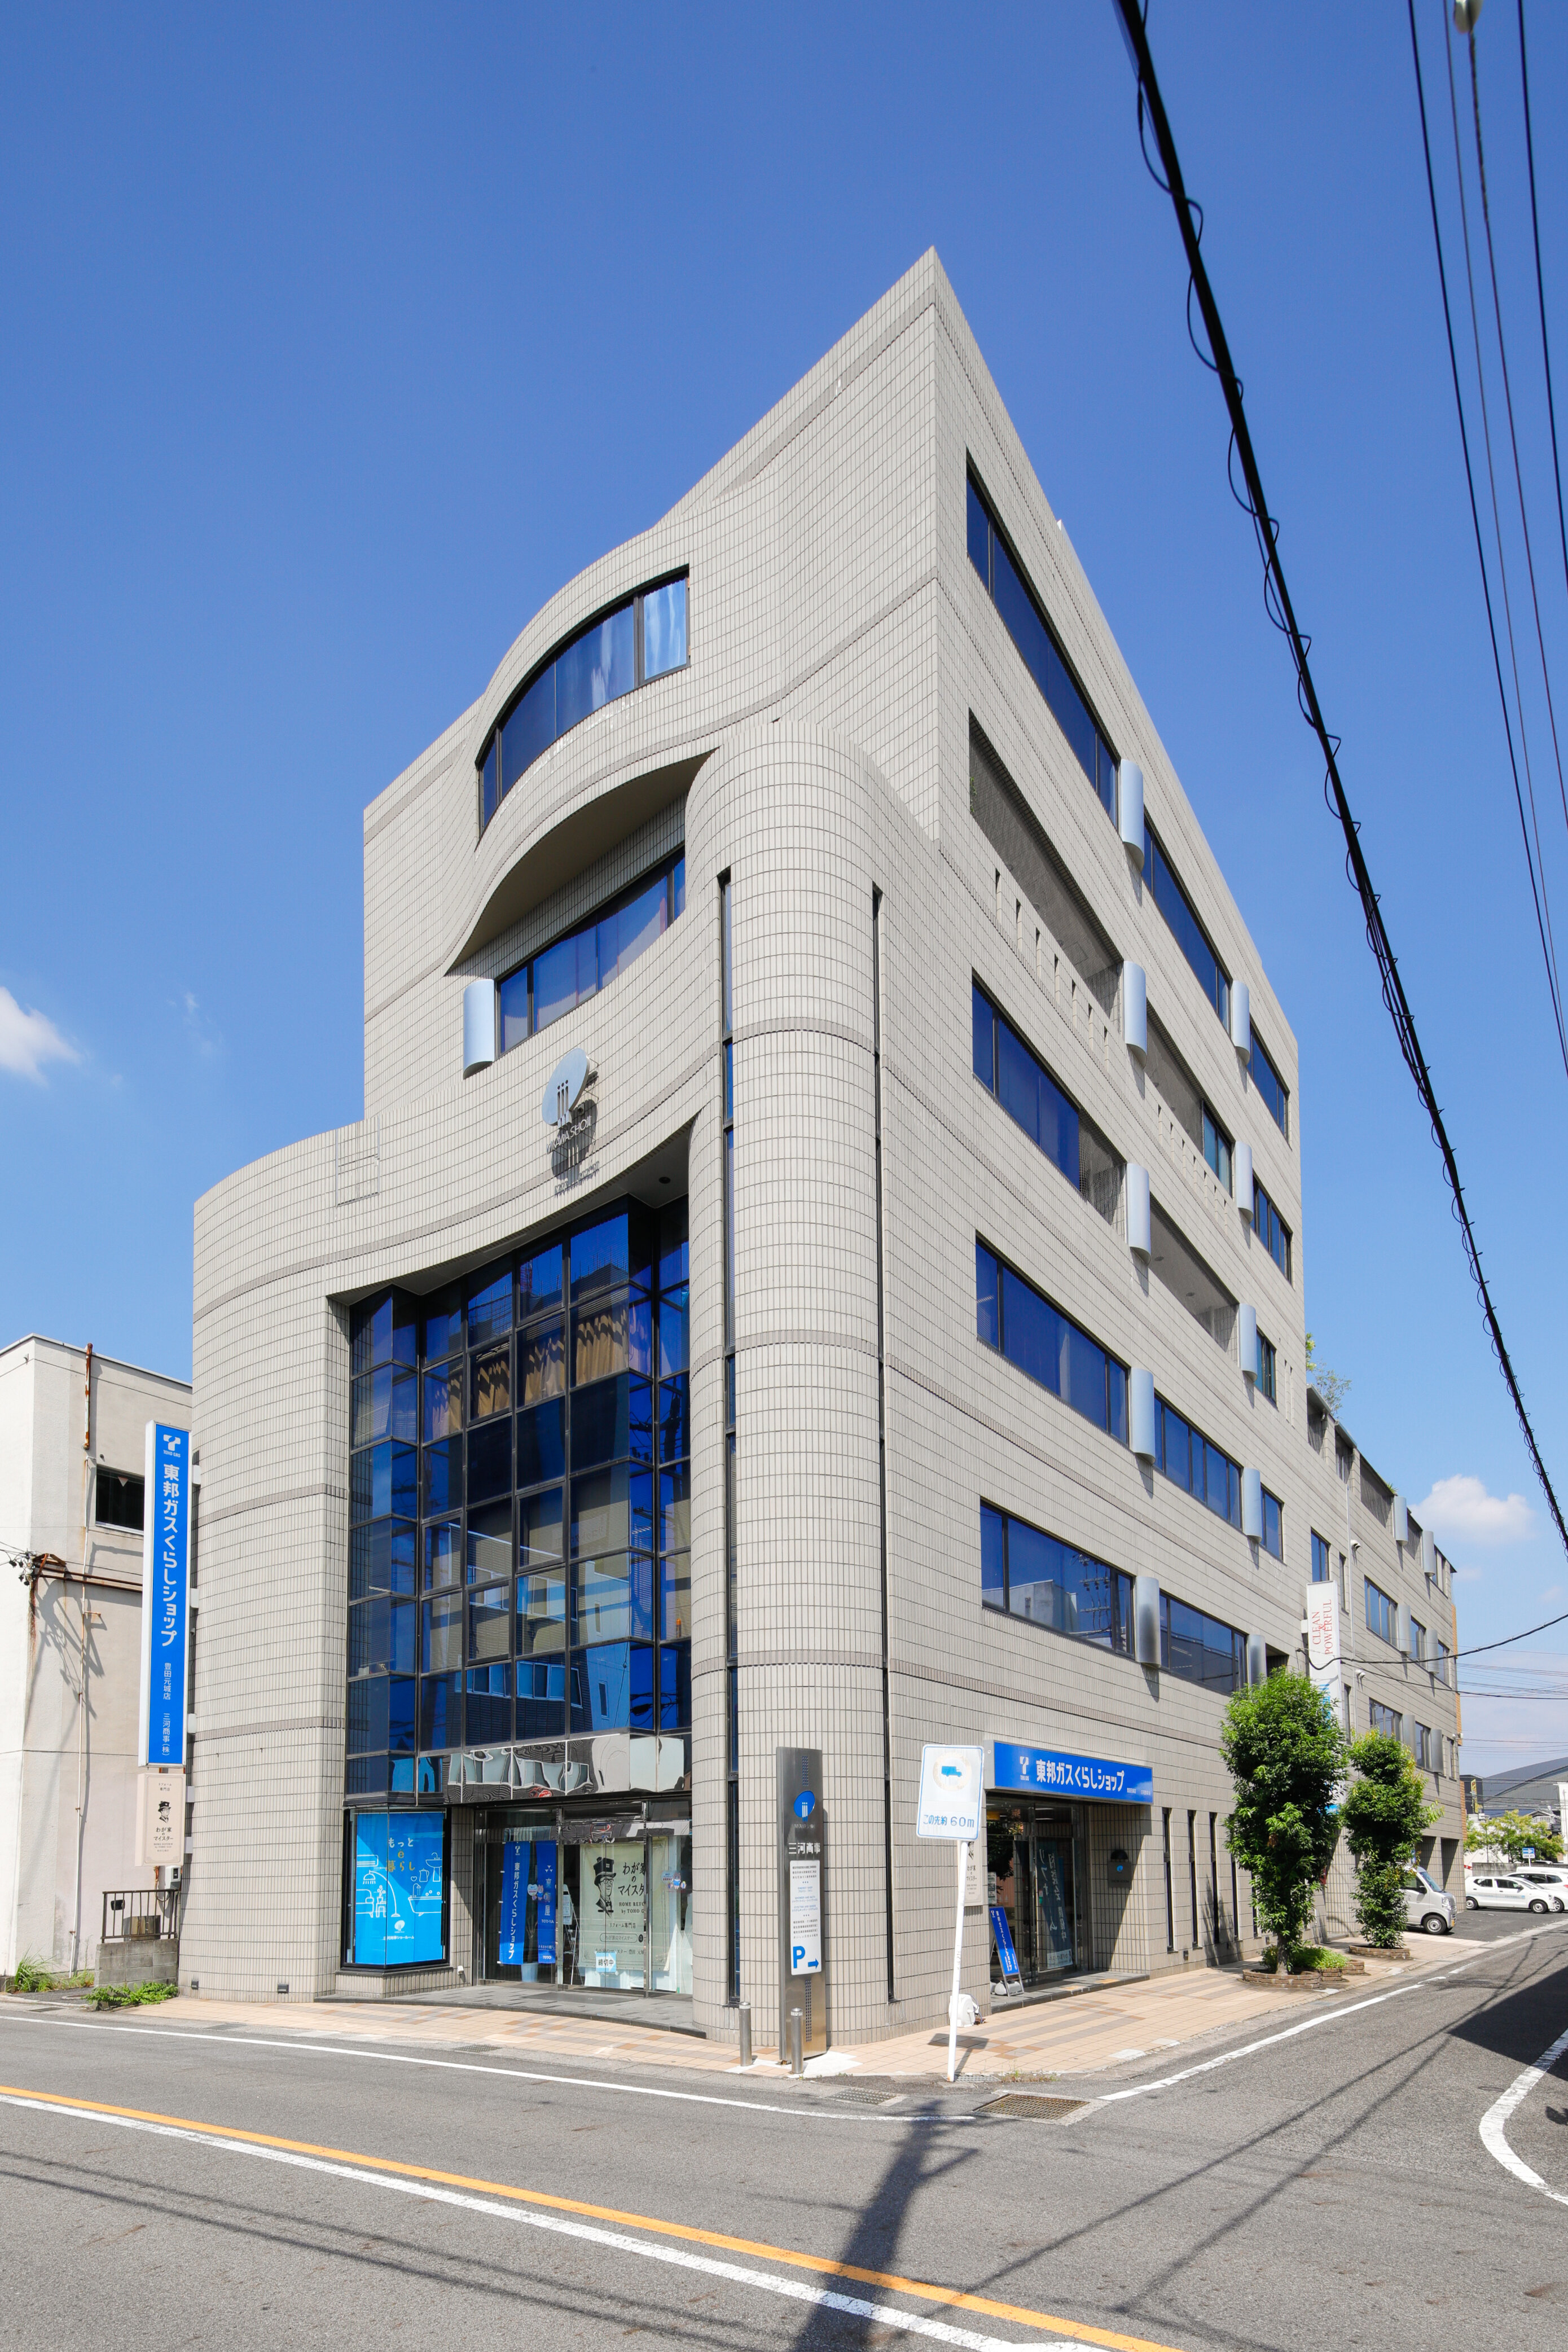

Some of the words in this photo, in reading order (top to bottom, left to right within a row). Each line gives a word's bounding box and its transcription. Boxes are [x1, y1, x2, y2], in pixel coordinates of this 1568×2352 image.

[546, 1130, 570, 1155] MIKAWA
[570, 1116, 592, 1138] SHOJI
[161, 1464, 179, 1647] 東邦ガスくらしショップ
[1312, 1611, 1321, 1645] CLEAN
[1323, 1599, 1333, 1655] POWERFUL
[163, 1662, 172, 1700] 豊田元城店
[162, 1713, 170, 1756] 三河商事(株)
[1036, 1759, 1125, 1792] 東邦ガスくらしショップ
[923, 1815, 947, 1826] この先約
[950, 1816, 975, 1828] 60m
[388, 1837, 414, 1848] もっと
[788, 1842, 820, 1854] 三河商事
[386, 1860, 415, 1872] 暮らし
[508, 1862, 520, 1960] 東邦ガスくらしショップ
[793, 1946, 806, 1968] P
